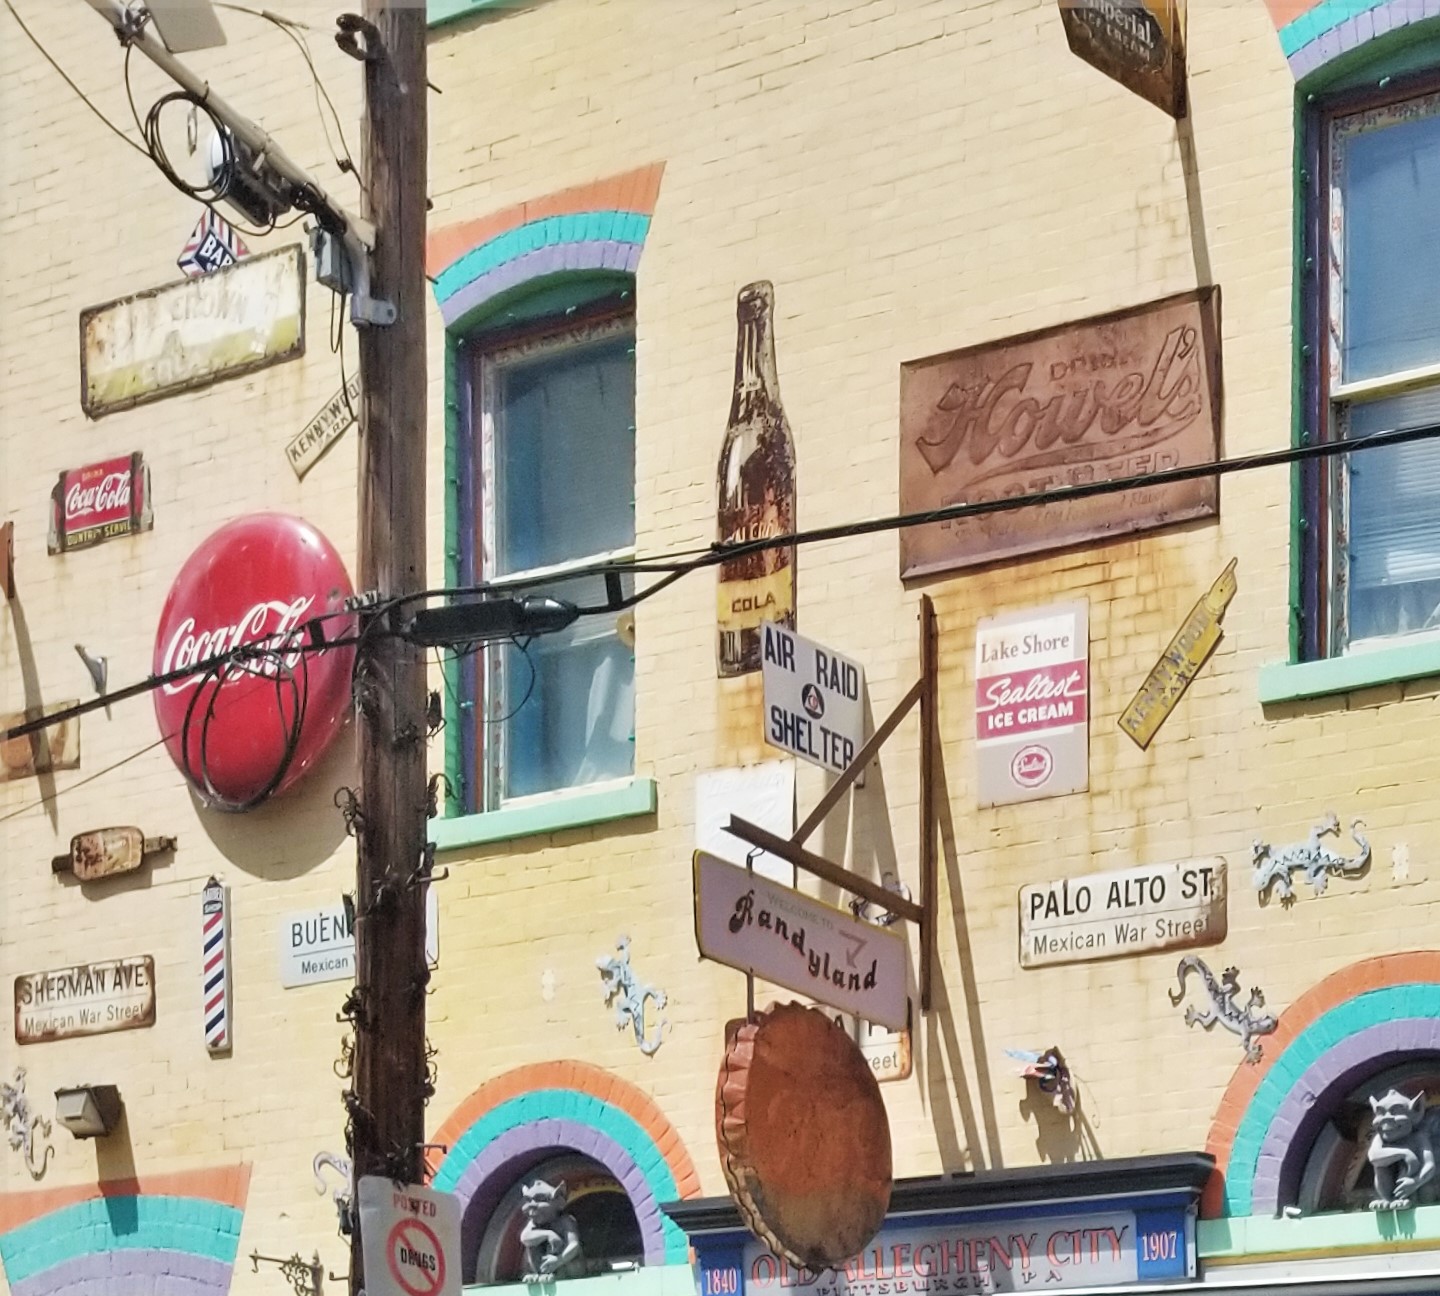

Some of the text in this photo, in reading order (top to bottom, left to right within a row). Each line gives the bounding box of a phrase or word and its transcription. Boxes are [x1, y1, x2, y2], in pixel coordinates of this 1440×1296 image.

[290, 376, 361, 462] KENNYWOO
[65, 470, 131, 519] Coca-Cola
[731, 591, 776, 614] COLA
[764, 626, 858, 701] AIR RAID
[981, 633, 1070, 664] Lake Shore
[977, 669, 1087, 713] Sealtest
[987, 701, 1074, 730] ICE CREAM
[771, 704, 854, 771] SHELTER
[1031, 867, 1215, 921] PALO ALTO ST.
[292, 916, 355, 948] BUEN
[728, 889, 878, 991] Randyland
[1033, 916, 1210, 955] Mexican War Street
[22, 964, 148, 1006] SHERMAN AVE.
[301, 957, 349, 974] Mexican
[25, 1003, 144, 1034] Mexican War Street
[400, 1248, 437, 1272] DRUGS
[752, 1225, 1130, 1289] OLD ALLEGHENY CITY
[1141, 1231, 1178, 1262] 1907
[705, 1268, 737, 1296] 1840
